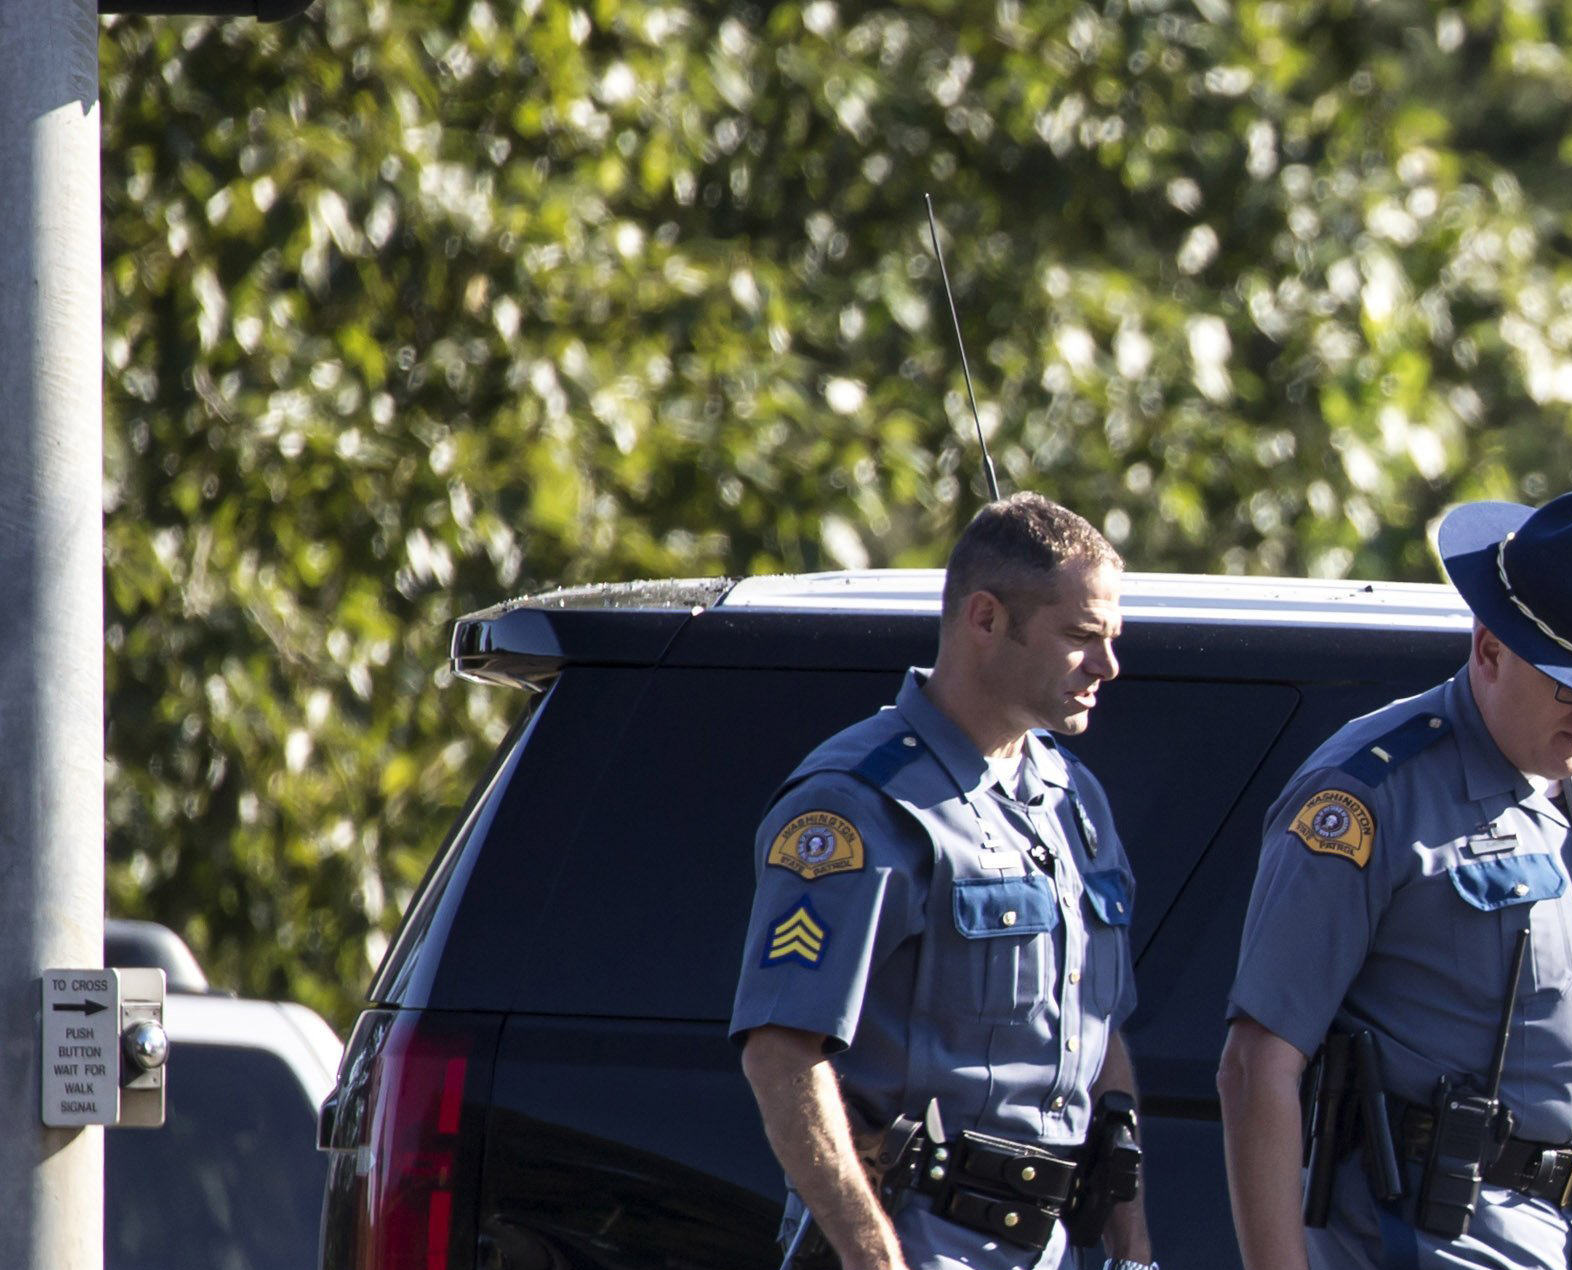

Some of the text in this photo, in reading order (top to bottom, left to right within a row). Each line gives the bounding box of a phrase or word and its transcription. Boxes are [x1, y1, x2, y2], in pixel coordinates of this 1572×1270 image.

[1306, 792, 1371, 836] WASHINGTON
[782, 814, 855, 842] WASHINGTON
[52, 979, 108, 991] TO CROSS
[65, 1027, 94, 1040] PUSH
[58, 1046, 101, 1058] BUTTON
[53, 1064, 106, 1076] WAIT FOR
[64, 1082, 94, 1095] WALK
[60, 1101, 97, 1113] SIGNAL
